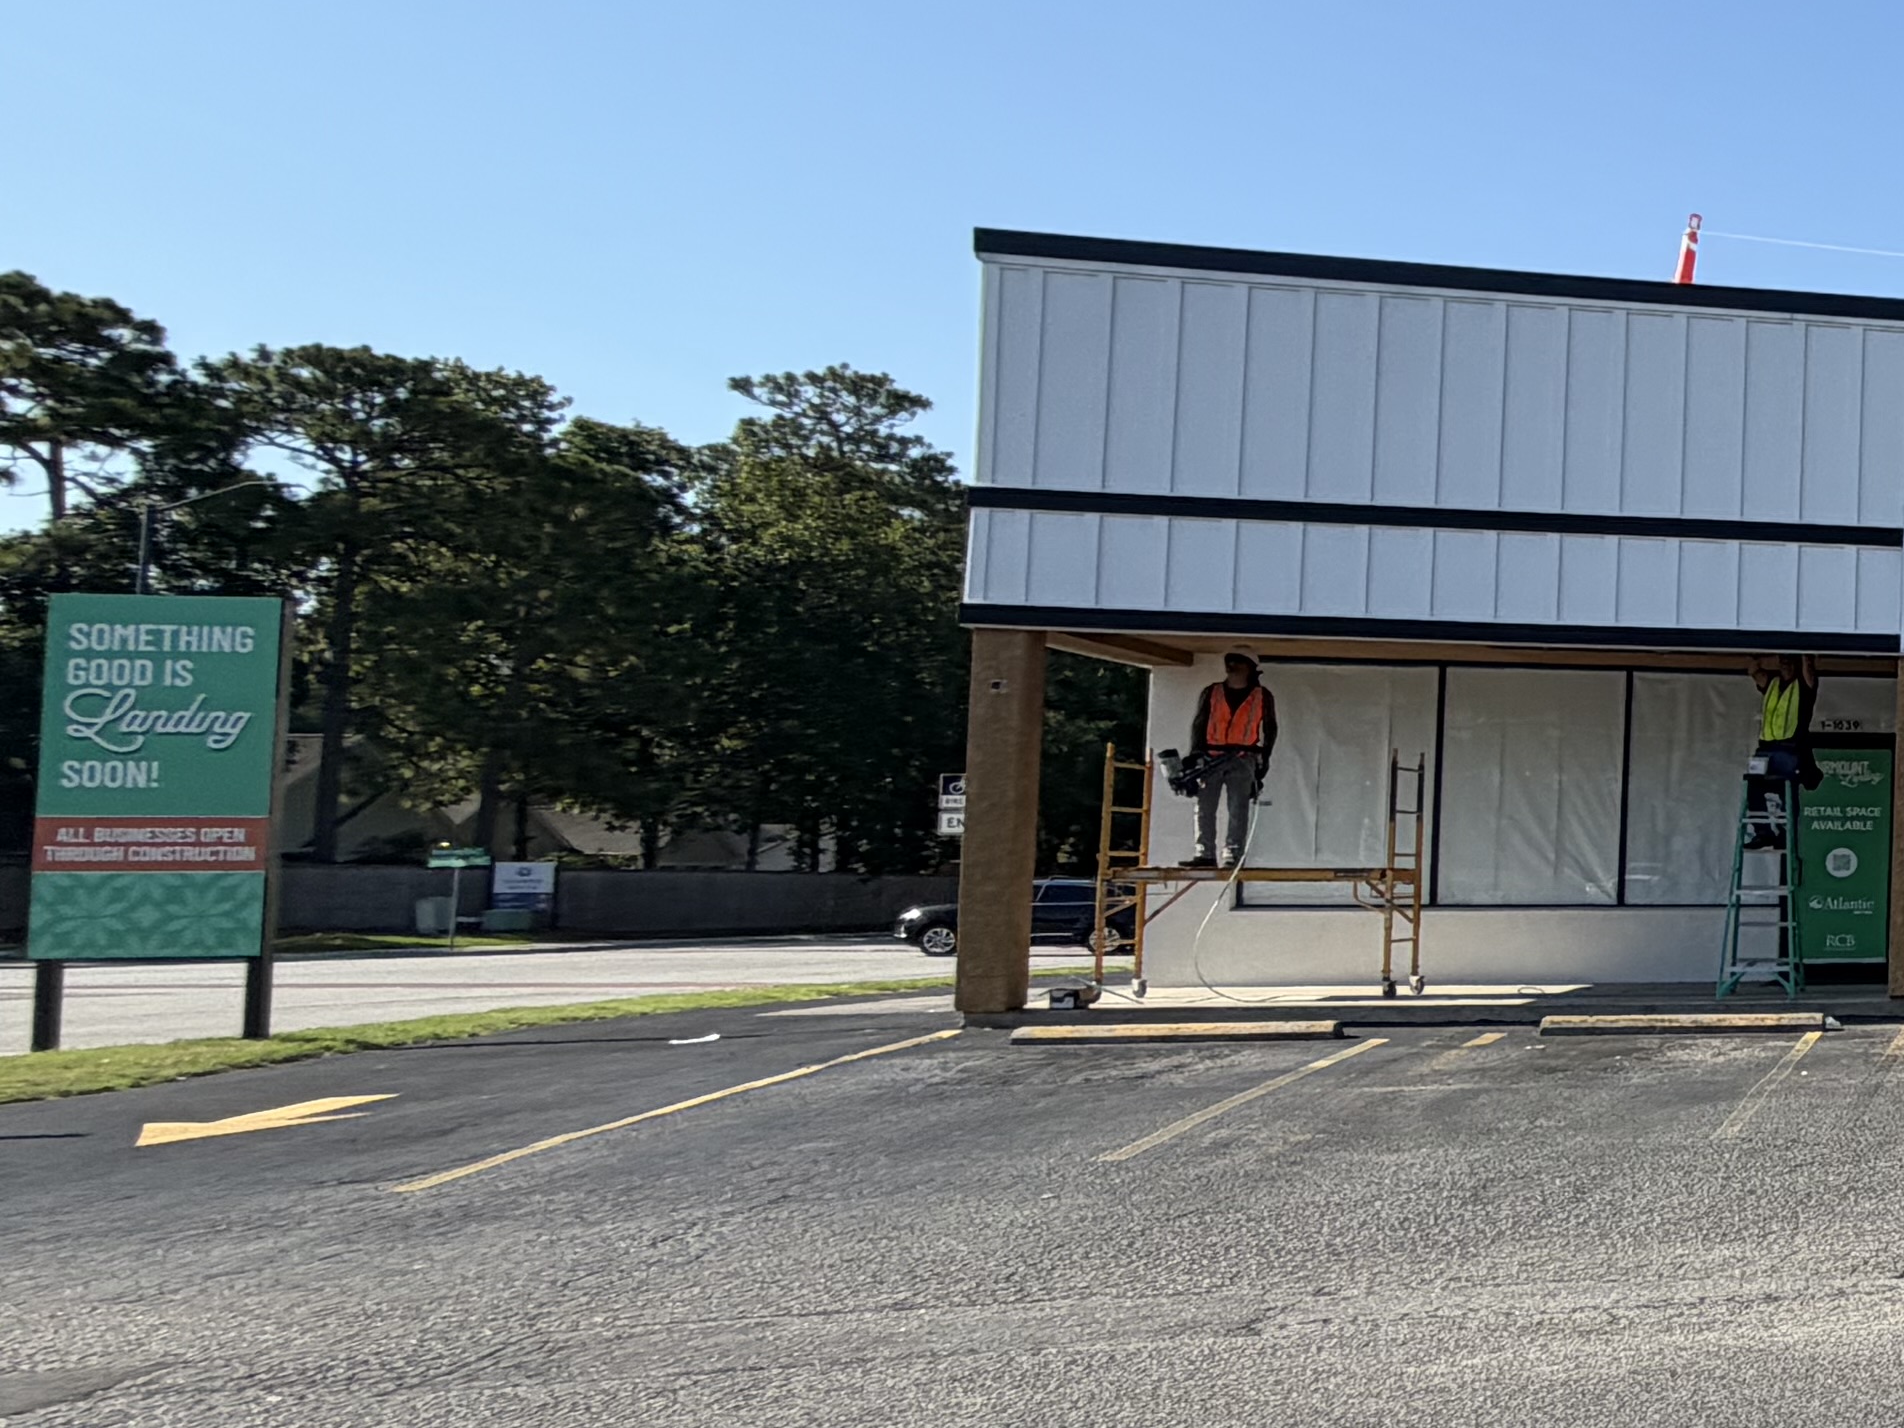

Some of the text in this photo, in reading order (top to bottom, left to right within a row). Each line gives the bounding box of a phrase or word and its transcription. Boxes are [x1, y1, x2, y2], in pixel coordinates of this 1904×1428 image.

[68, 622, 256, 653] SOMETHING
[66, 657, 194, 687] GOOD IS
[63, 688, 252, 754] Landing
[60, 760, 160, 789] SOON!
[1803, 806, 1882, 817] RETAIL SPACE
[56, 827, 91, 843] ALL
[199, 827, 246, 843] OPEN
[1811, 820, 1874, 831] AVAILABLE
[1825, 896, 1875, 910] Atlantic
